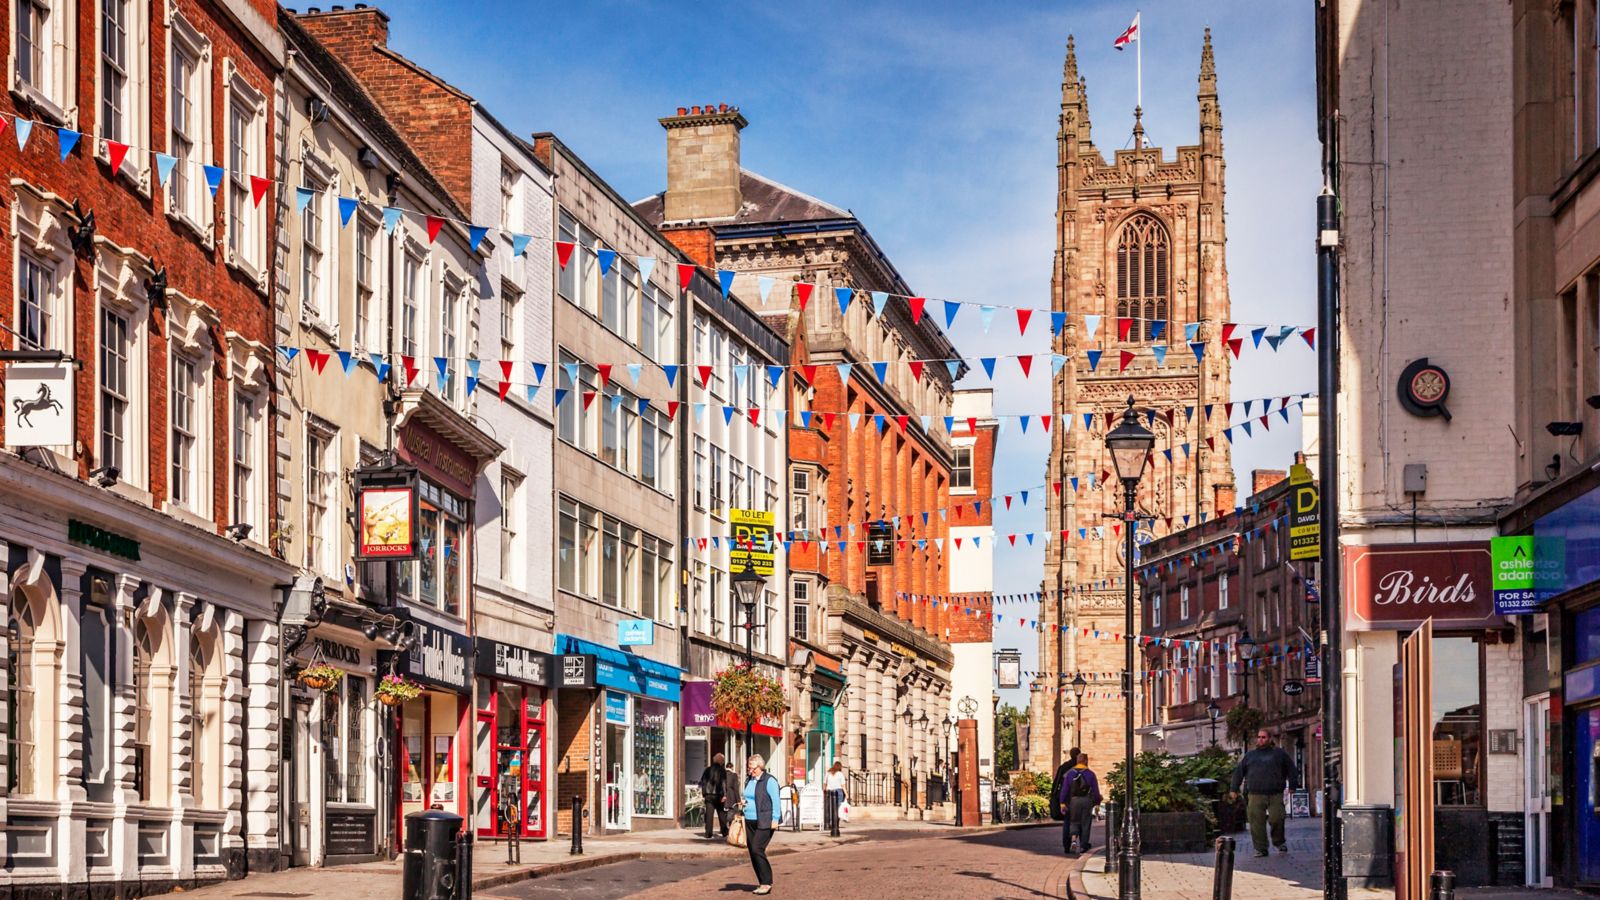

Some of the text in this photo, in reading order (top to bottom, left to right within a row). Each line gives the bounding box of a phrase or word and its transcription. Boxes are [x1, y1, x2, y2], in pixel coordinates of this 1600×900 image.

[404, 425, 474, 487] Musical Instruments
[741, 510, 765, 519] TO LET
[1297, 514, 1315, 523] DAVID
[1293, 537, 1314, 546] 01332
[367, 545, 407, 554] JORROCKS
[1499, 558, 1535, 569] ashle
[1375, 570, 1476, 605] Birds
[1499, 592, 1536, 600] FOR SA
[1499, 600, 1520, 608] 01332
